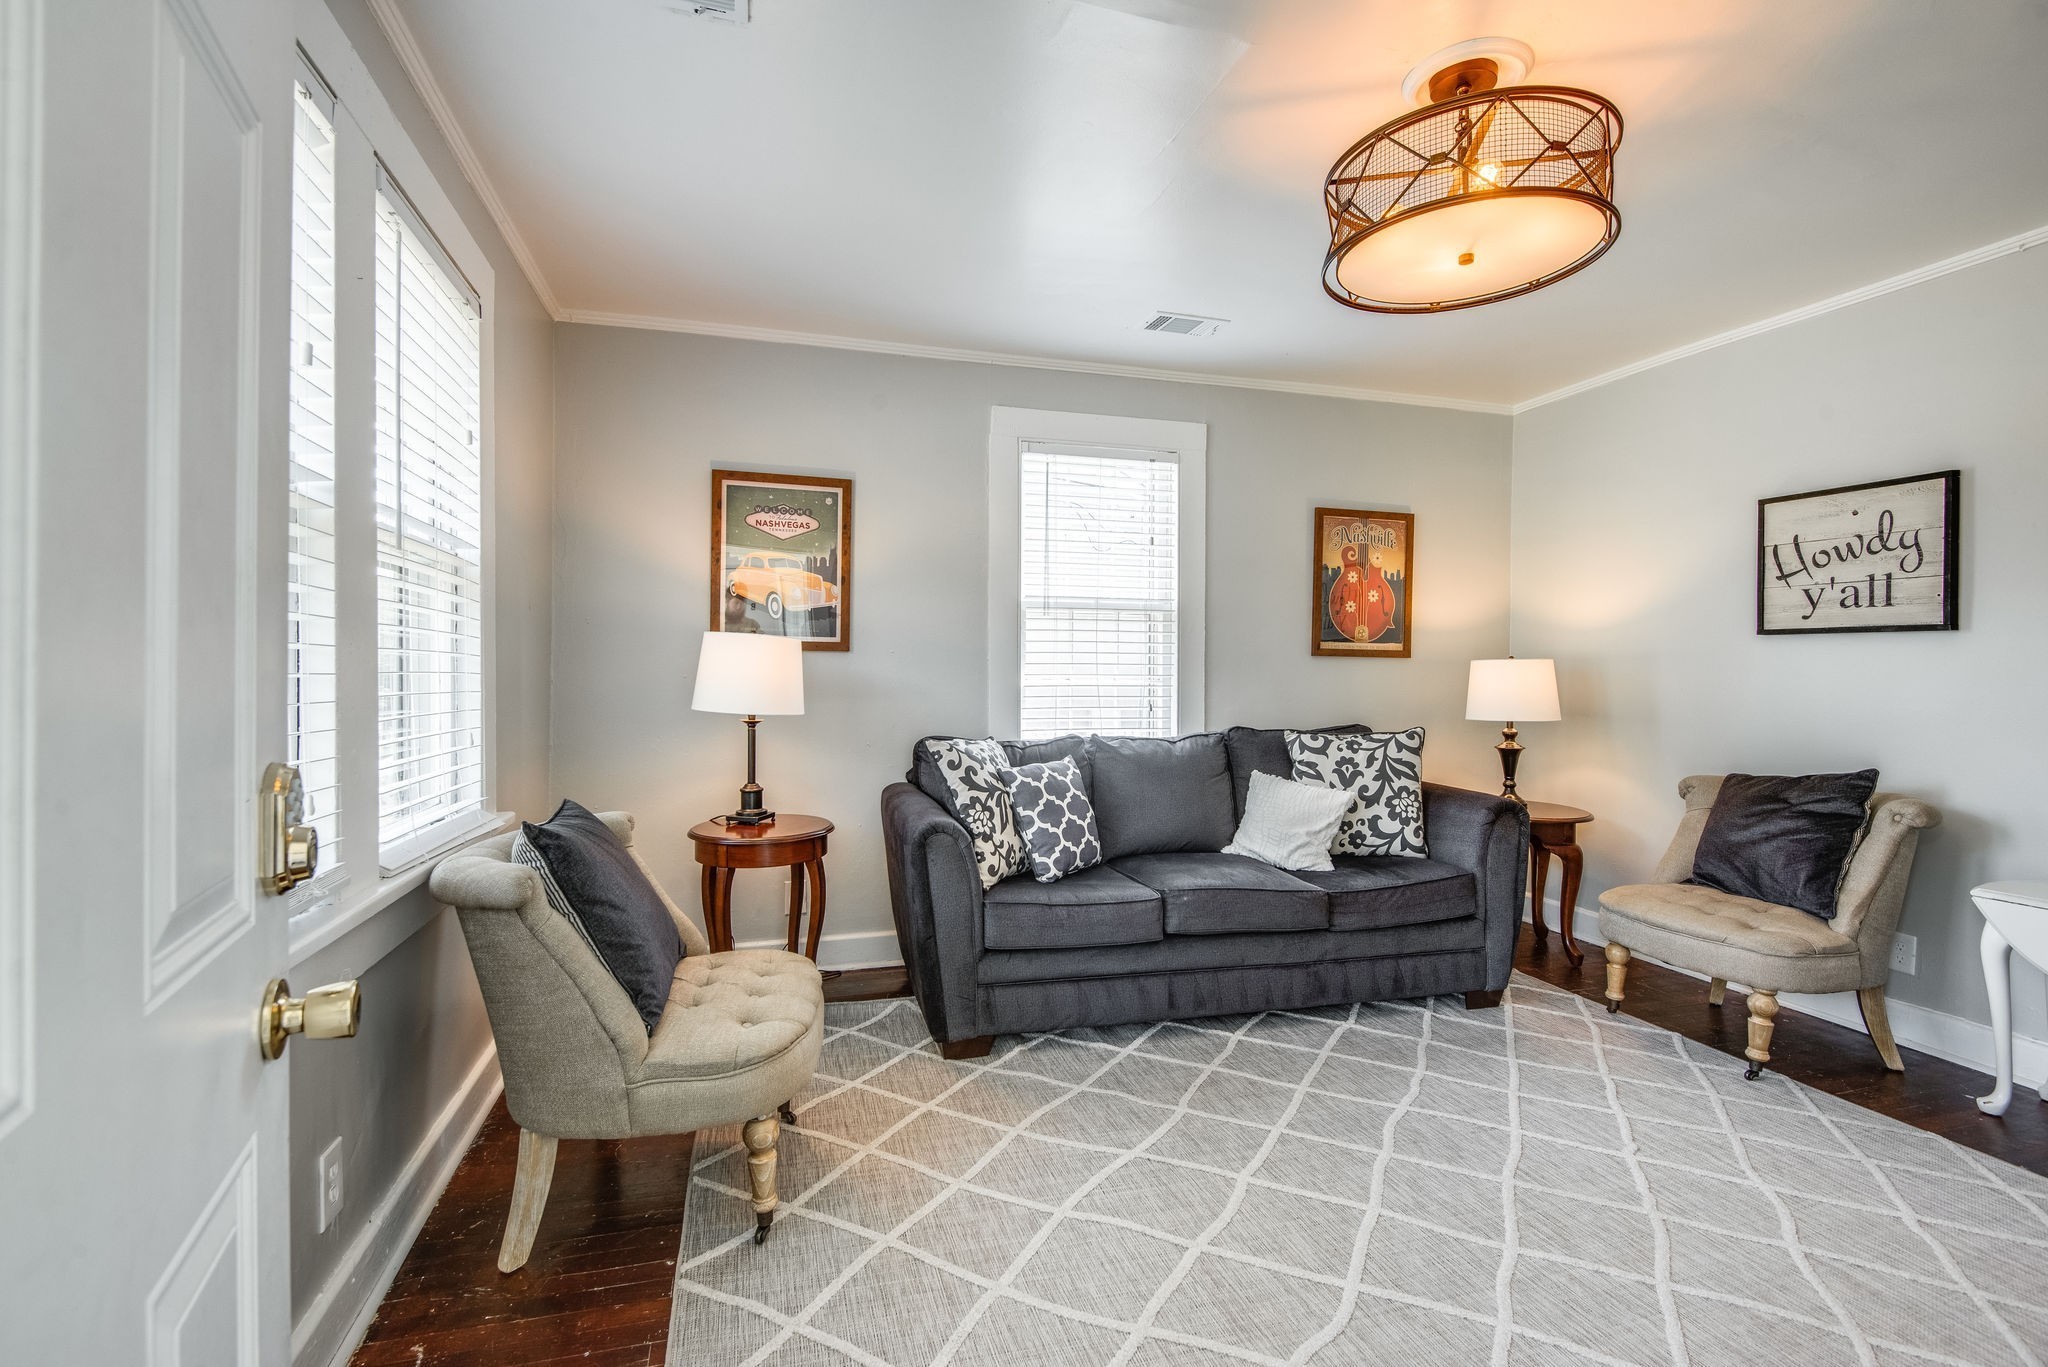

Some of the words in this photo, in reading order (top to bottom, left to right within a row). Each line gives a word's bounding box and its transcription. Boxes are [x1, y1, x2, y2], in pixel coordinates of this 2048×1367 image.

[755, 506, 811, 515] WELCOME
[755, 520, 811, 530] NASHVEGAS
[1330, 523, 1397, 551] Nashville
[1772, 509, 1924, 590] Howdy
[1801, 572, 1896, 620] y'all
